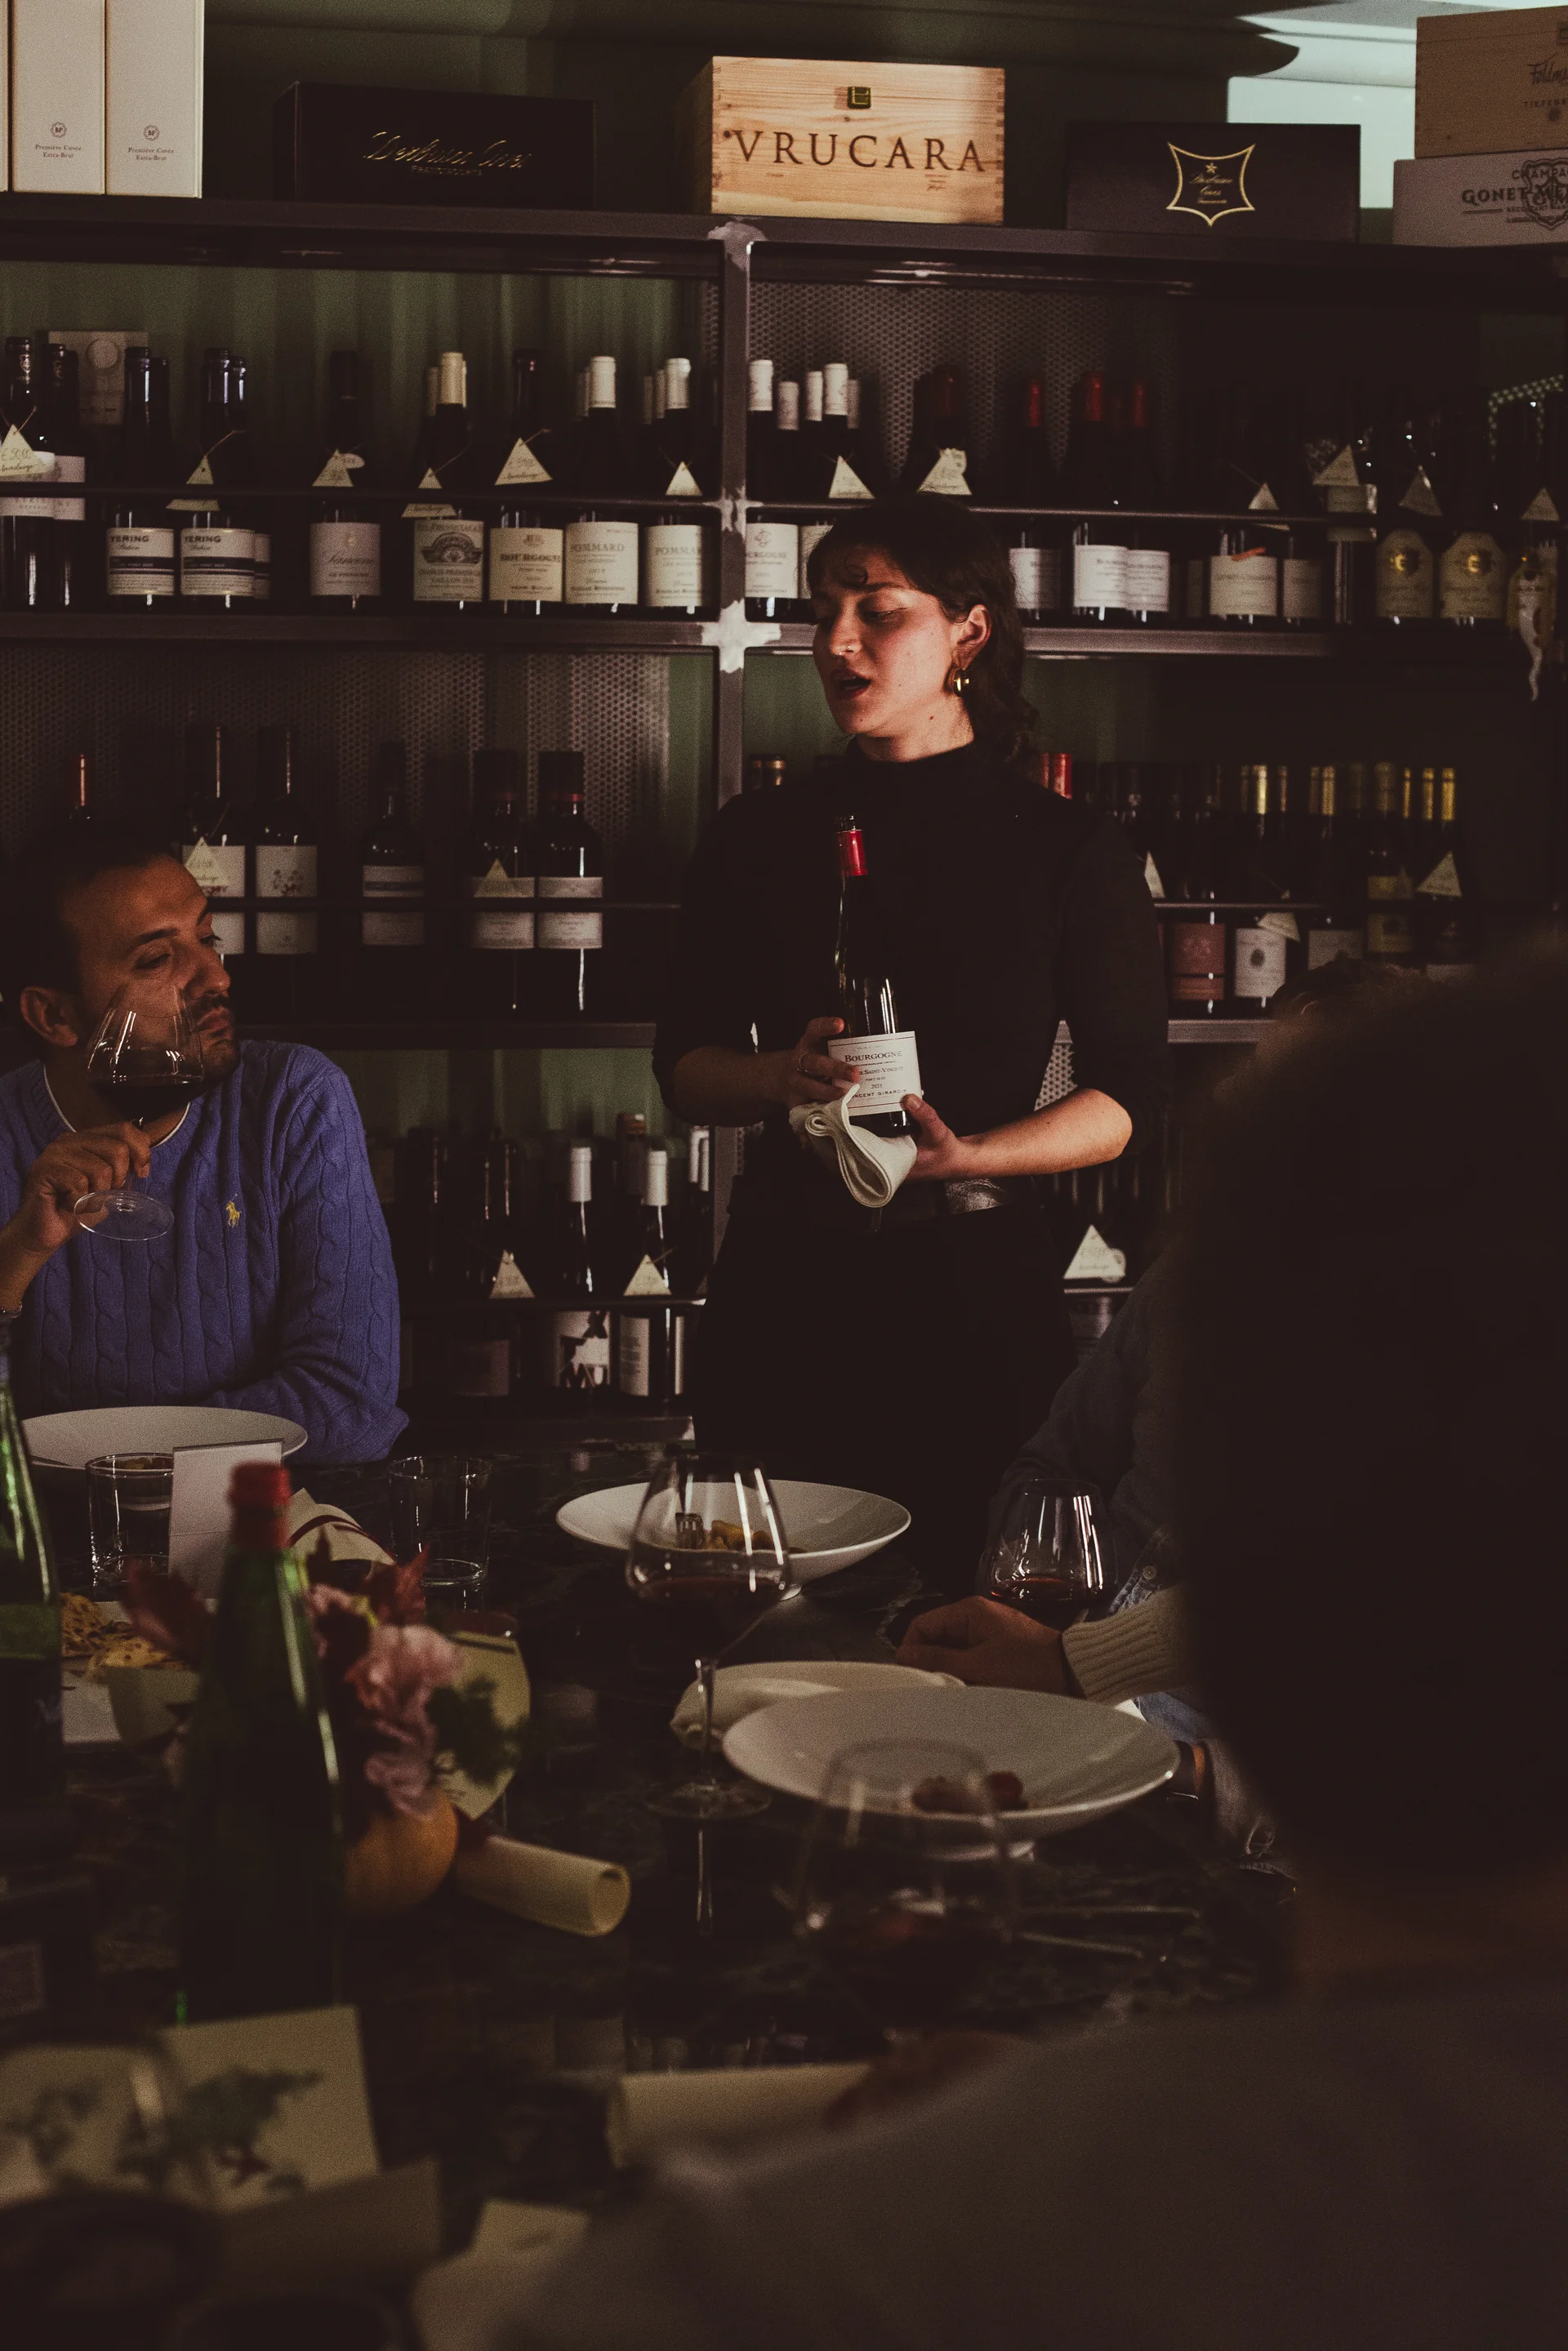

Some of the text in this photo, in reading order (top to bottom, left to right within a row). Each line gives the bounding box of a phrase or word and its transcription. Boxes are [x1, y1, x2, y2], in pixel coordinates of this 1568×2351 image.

[733, 130, 987, 172] VRUCARA
[110, 535, 149, 543] YERING
[185, 535, 221, 543] YERING
[844, 1050, 902, 1062] BOURGOGNE
